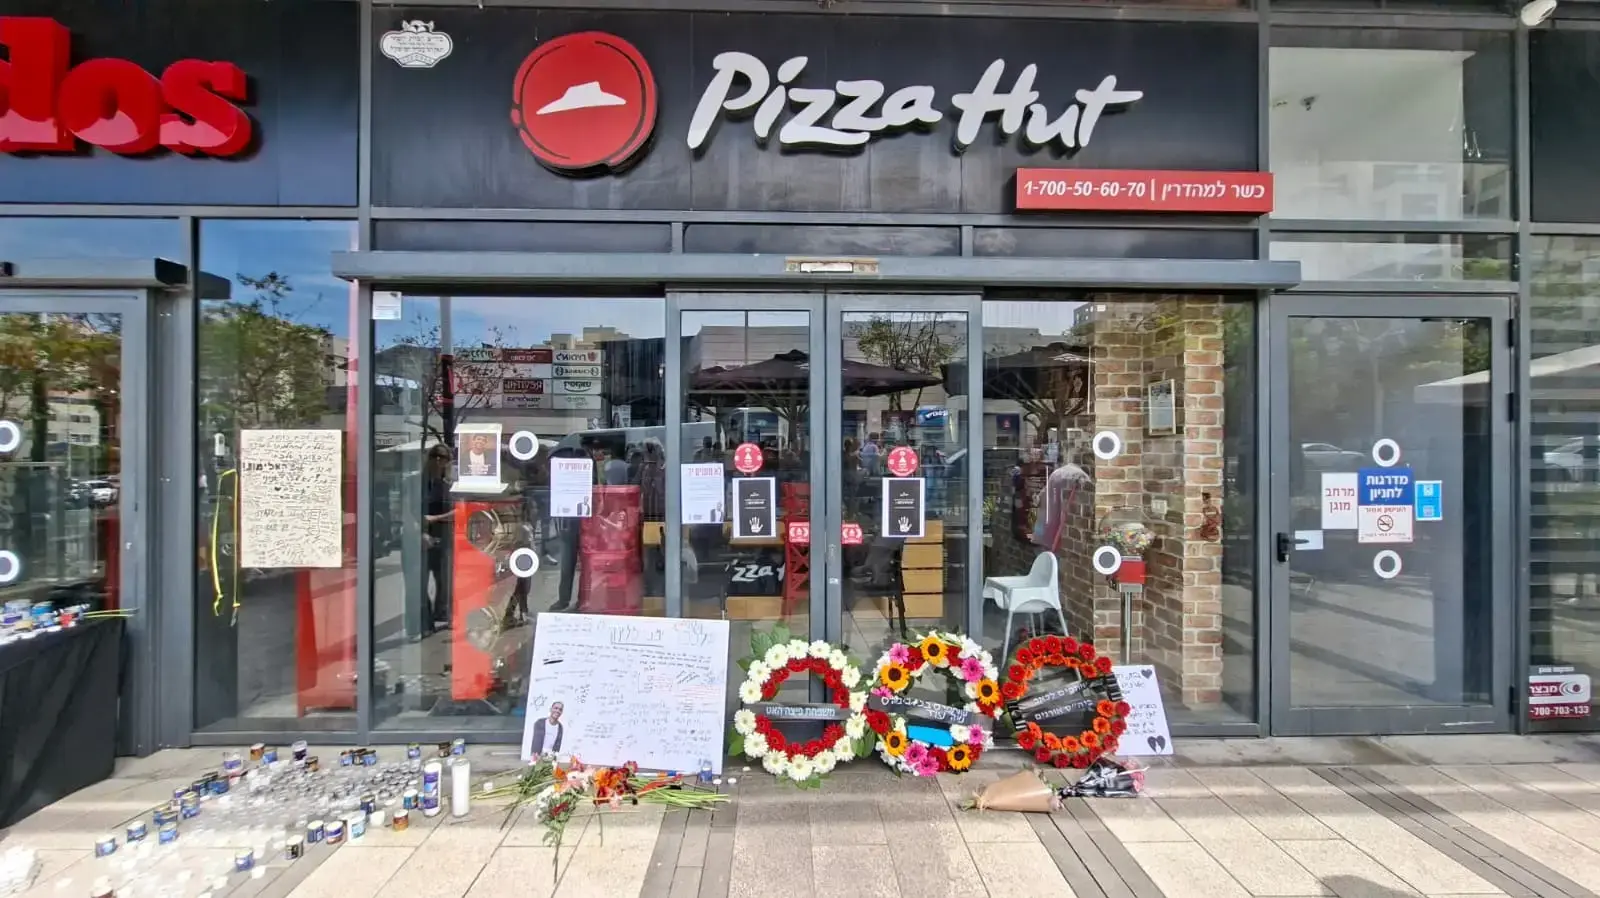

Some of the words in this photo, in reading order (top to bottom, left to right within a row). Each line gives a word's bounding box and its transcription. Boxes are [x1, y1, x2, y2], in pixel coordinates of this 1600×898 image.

[686, 51, 943, 149] Pizza
[951, 58, 1144, 149] Hut
[1023, 179, 1146, 197] 1-700-50-60-70
[1161, 178, 1227, 201] למהדרין
[1230, 183, 1266, 198] כשר
[1366, 475, 1409, 486] מדרגות
[1325, 488, 1355, 497] מרחב
[1370, 487, 1403, 502] לחניון
[1329, 501, 1351, 513] מוגן
[724, 559, 774, 582] zza
[1529, 705, 1590, 716] -700-703-133
